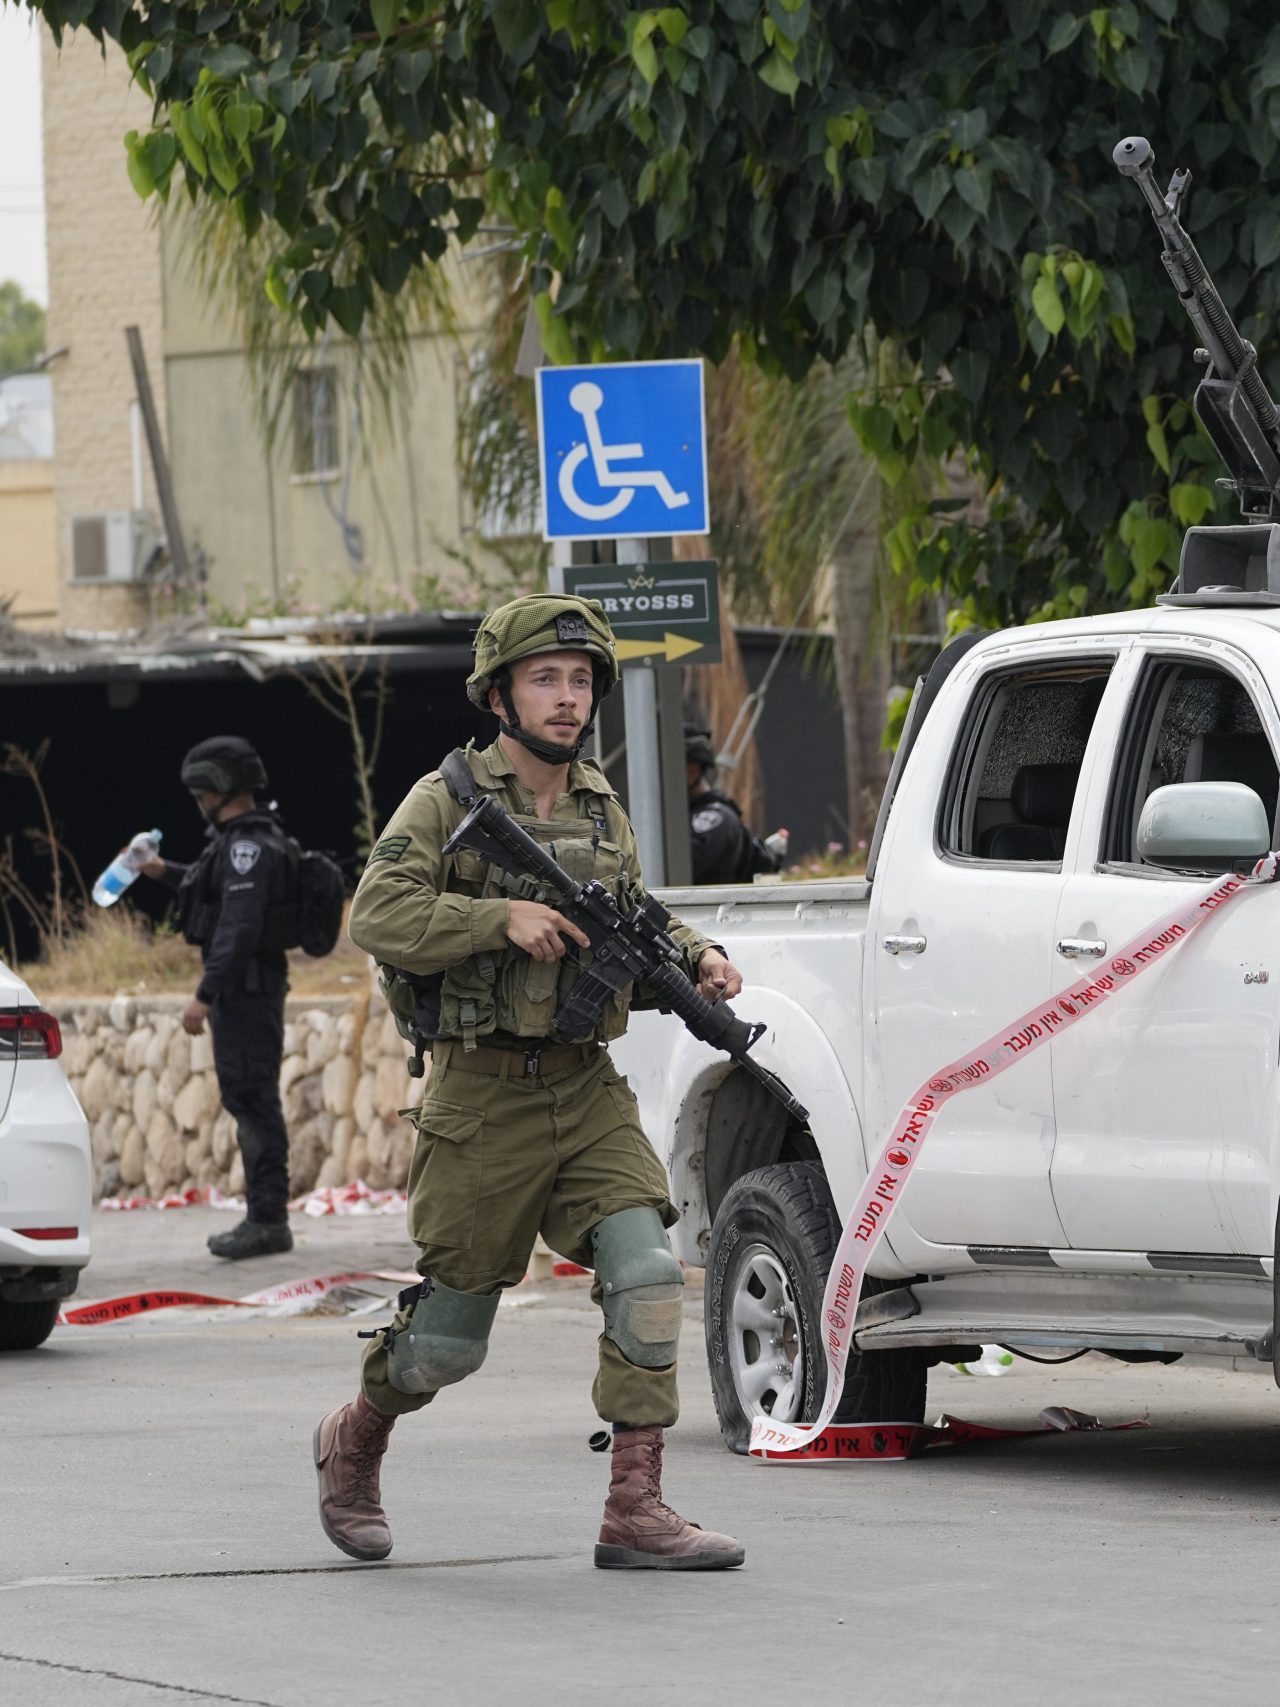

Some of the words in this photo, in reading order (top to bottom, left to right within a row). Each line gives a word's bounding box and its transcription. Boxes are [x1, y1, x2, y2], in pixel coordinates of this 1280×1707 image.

[603, 593, 695, 613] RYOSSS
[1200, 880, 1240, 910] מעבר
[1132, 923, 1186, 964] משטרת
[1070, 975, 1114, 1006] ישראל
[1038, 1010, 1063, 1034] אין
[1002, 1023, 1043, 1053] מעבר
[896, 1094, 935, 1144] ישראל
[875, 1174, 898, 1202] אין
[854, 1201, 884, 1242] מעבר
[834, 1263, 855, 1314] משטרת
[834, 1437, 860, 1457] אין
